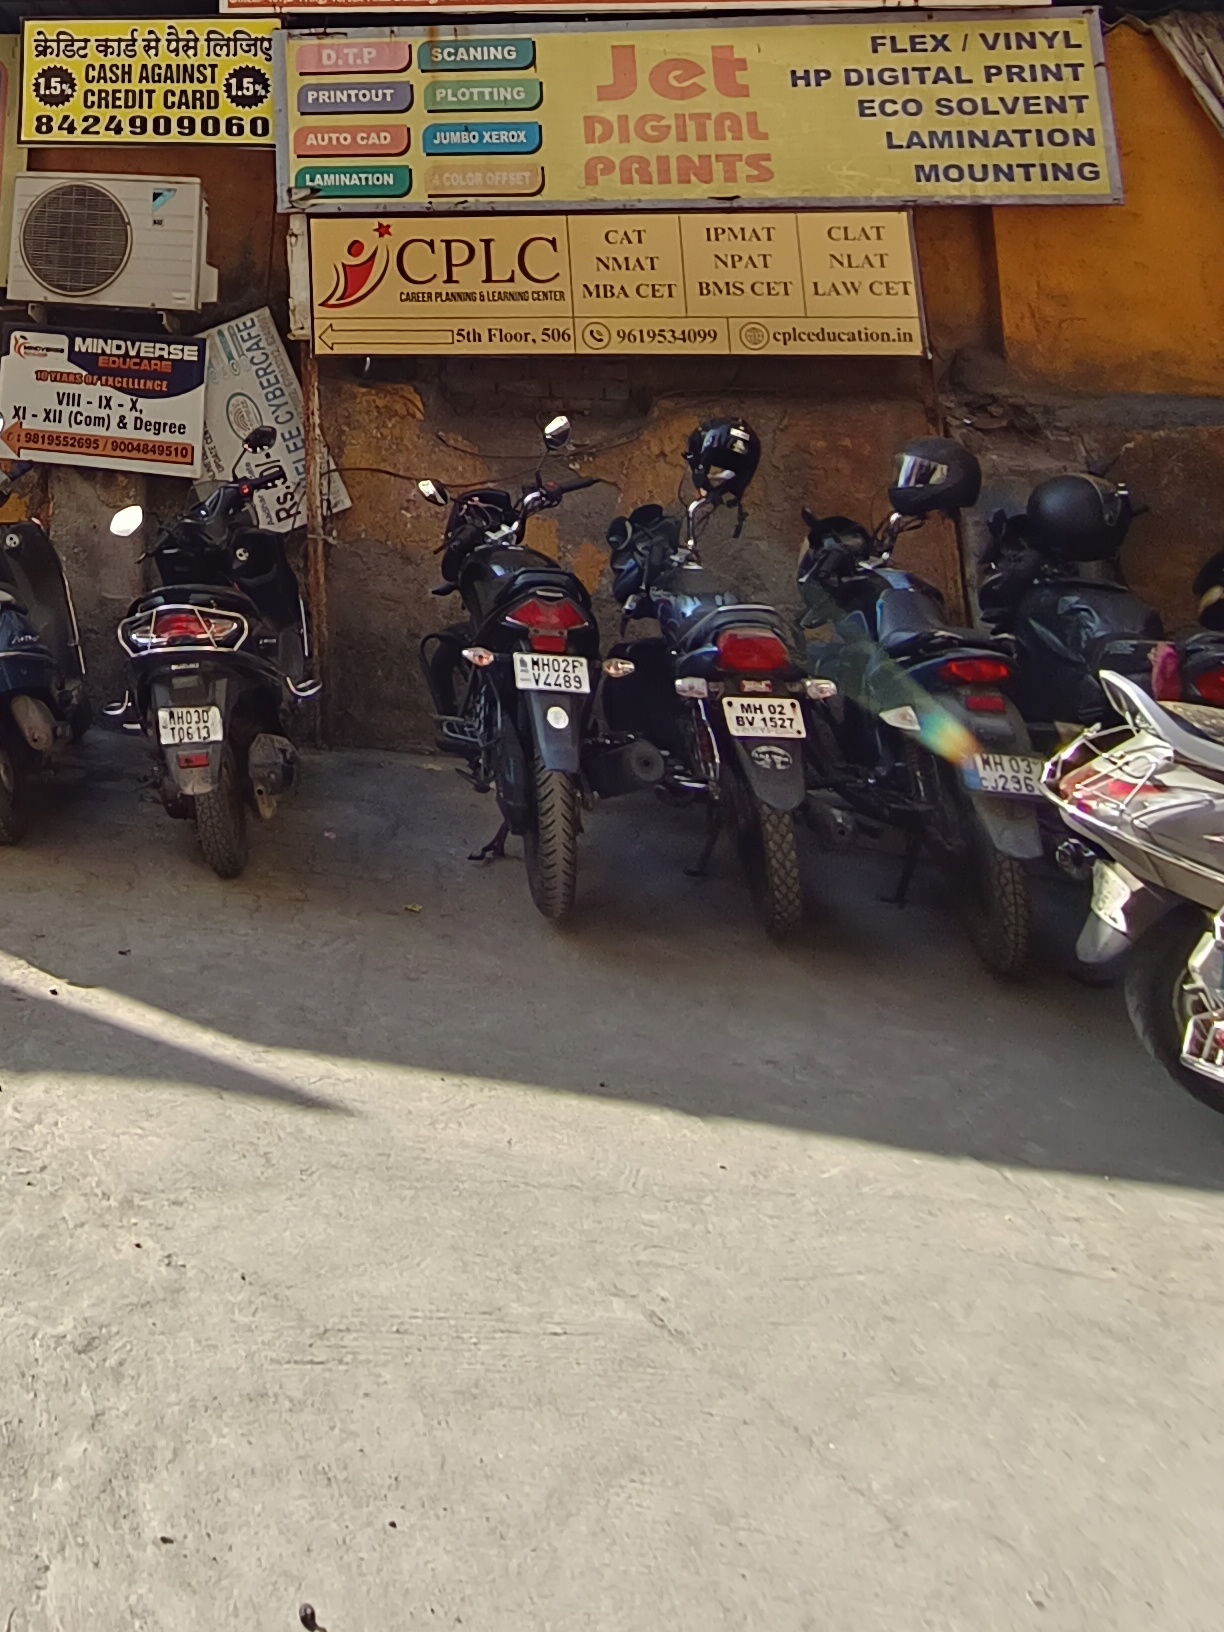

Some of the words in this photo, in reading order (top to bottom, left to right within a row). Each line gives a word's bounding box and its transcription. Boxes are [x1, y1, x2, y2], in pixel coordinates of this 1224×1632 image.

[34, 30, 91, 59] क्रेडिट
[94, 28, 138, 59] कार्ड
[142, 29, 161, 59] से
[165, 25, 200, 59] पैसे
[205, 29, 273, 62] लिजिए
[431, 46, 517, 62] SCANING
[84, 63, 133, 84] CASH
[138, 63, 218, 85] AGAINST
[596, 44, 751, 103] Jet
[790, 68, 832, 88] HP
[844, 65, 973, 86] DIGITAL
[984, 62, 1085, 84] PRINT
[37, 78, 72, 96] 1.5%
[228, 77, 266, 96] 1.5%
[435, 87, 526, 102] PLOTTING
[83, 89, 156, 110] CREDIT
[162, 89, 219, 110] CARD
[307, 89, 395, 104] PRINTOUT
[857, 98, 923, 118] ECO
[935, 94, 1089, 116] SOLVENT
[34, 114, 270, 137] 8424909060
[583, 111, 769, 145] DIGITAL
[886, 127, 1095, 150] LAMINATION
[583, 153, 775, 187] PRINTS
[914, 162, 1101, 183] MOUNTING
[305, 173, 394, 187] LAMINATION
[604, 229, 647, 245] CAT
[705, 226, 776, 242] IPMAT
[826, 225, 886, 242] CLAT
[396, 236, 560, 285] CPLC
[582, 283, 629, 299] MBA
[635, 283, 677, 299] CET
[455, 328, 482, 343] 5th
[487, 328, 537, 344] Floor,
[541, 328, 571, 343] 506
[616, 328, 718, 346] 9619534099
[773, 327, 913, 347] cplceducation.in
[74, 337, 198, 361] MINDVERSE
[98, 356, 172, 373] EDUCARE
[236, 317, 295, 425] CYBERCAFE
[740, 702, 763, 715] MH
[767, 704, 786, 716] 02
[736, 715, 755, 728] BV
[761, 717, 794, 730] 1527
